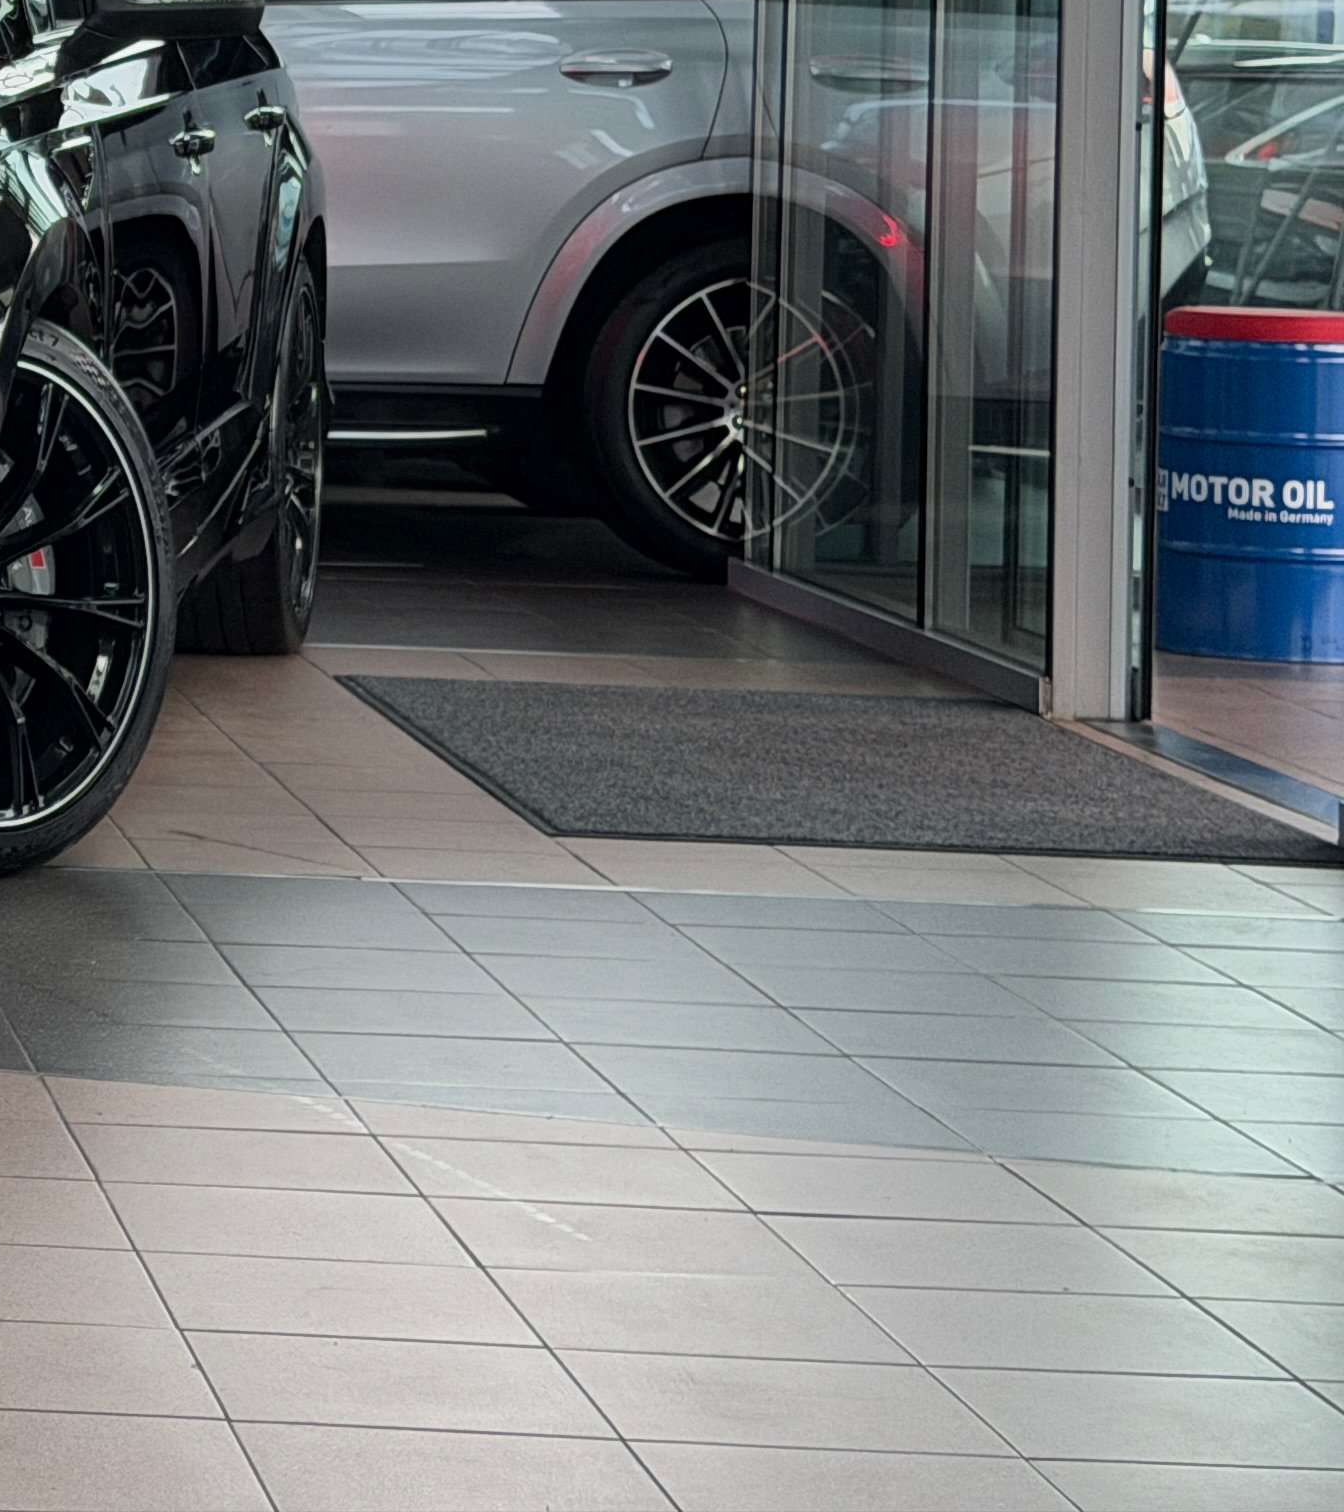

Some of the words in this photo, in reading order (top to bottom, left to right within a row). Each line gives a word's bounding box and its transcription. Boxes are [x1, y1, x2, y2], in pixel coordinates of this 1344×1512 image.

[1171, 471, 1276, 509] MOTOR
[1282, 479, 1336, 510] OIL
[1227, 507, 1262, 522] Made
[1264, 510, 1278, 523] in
[1279, 510, 1335, 527] Germany
